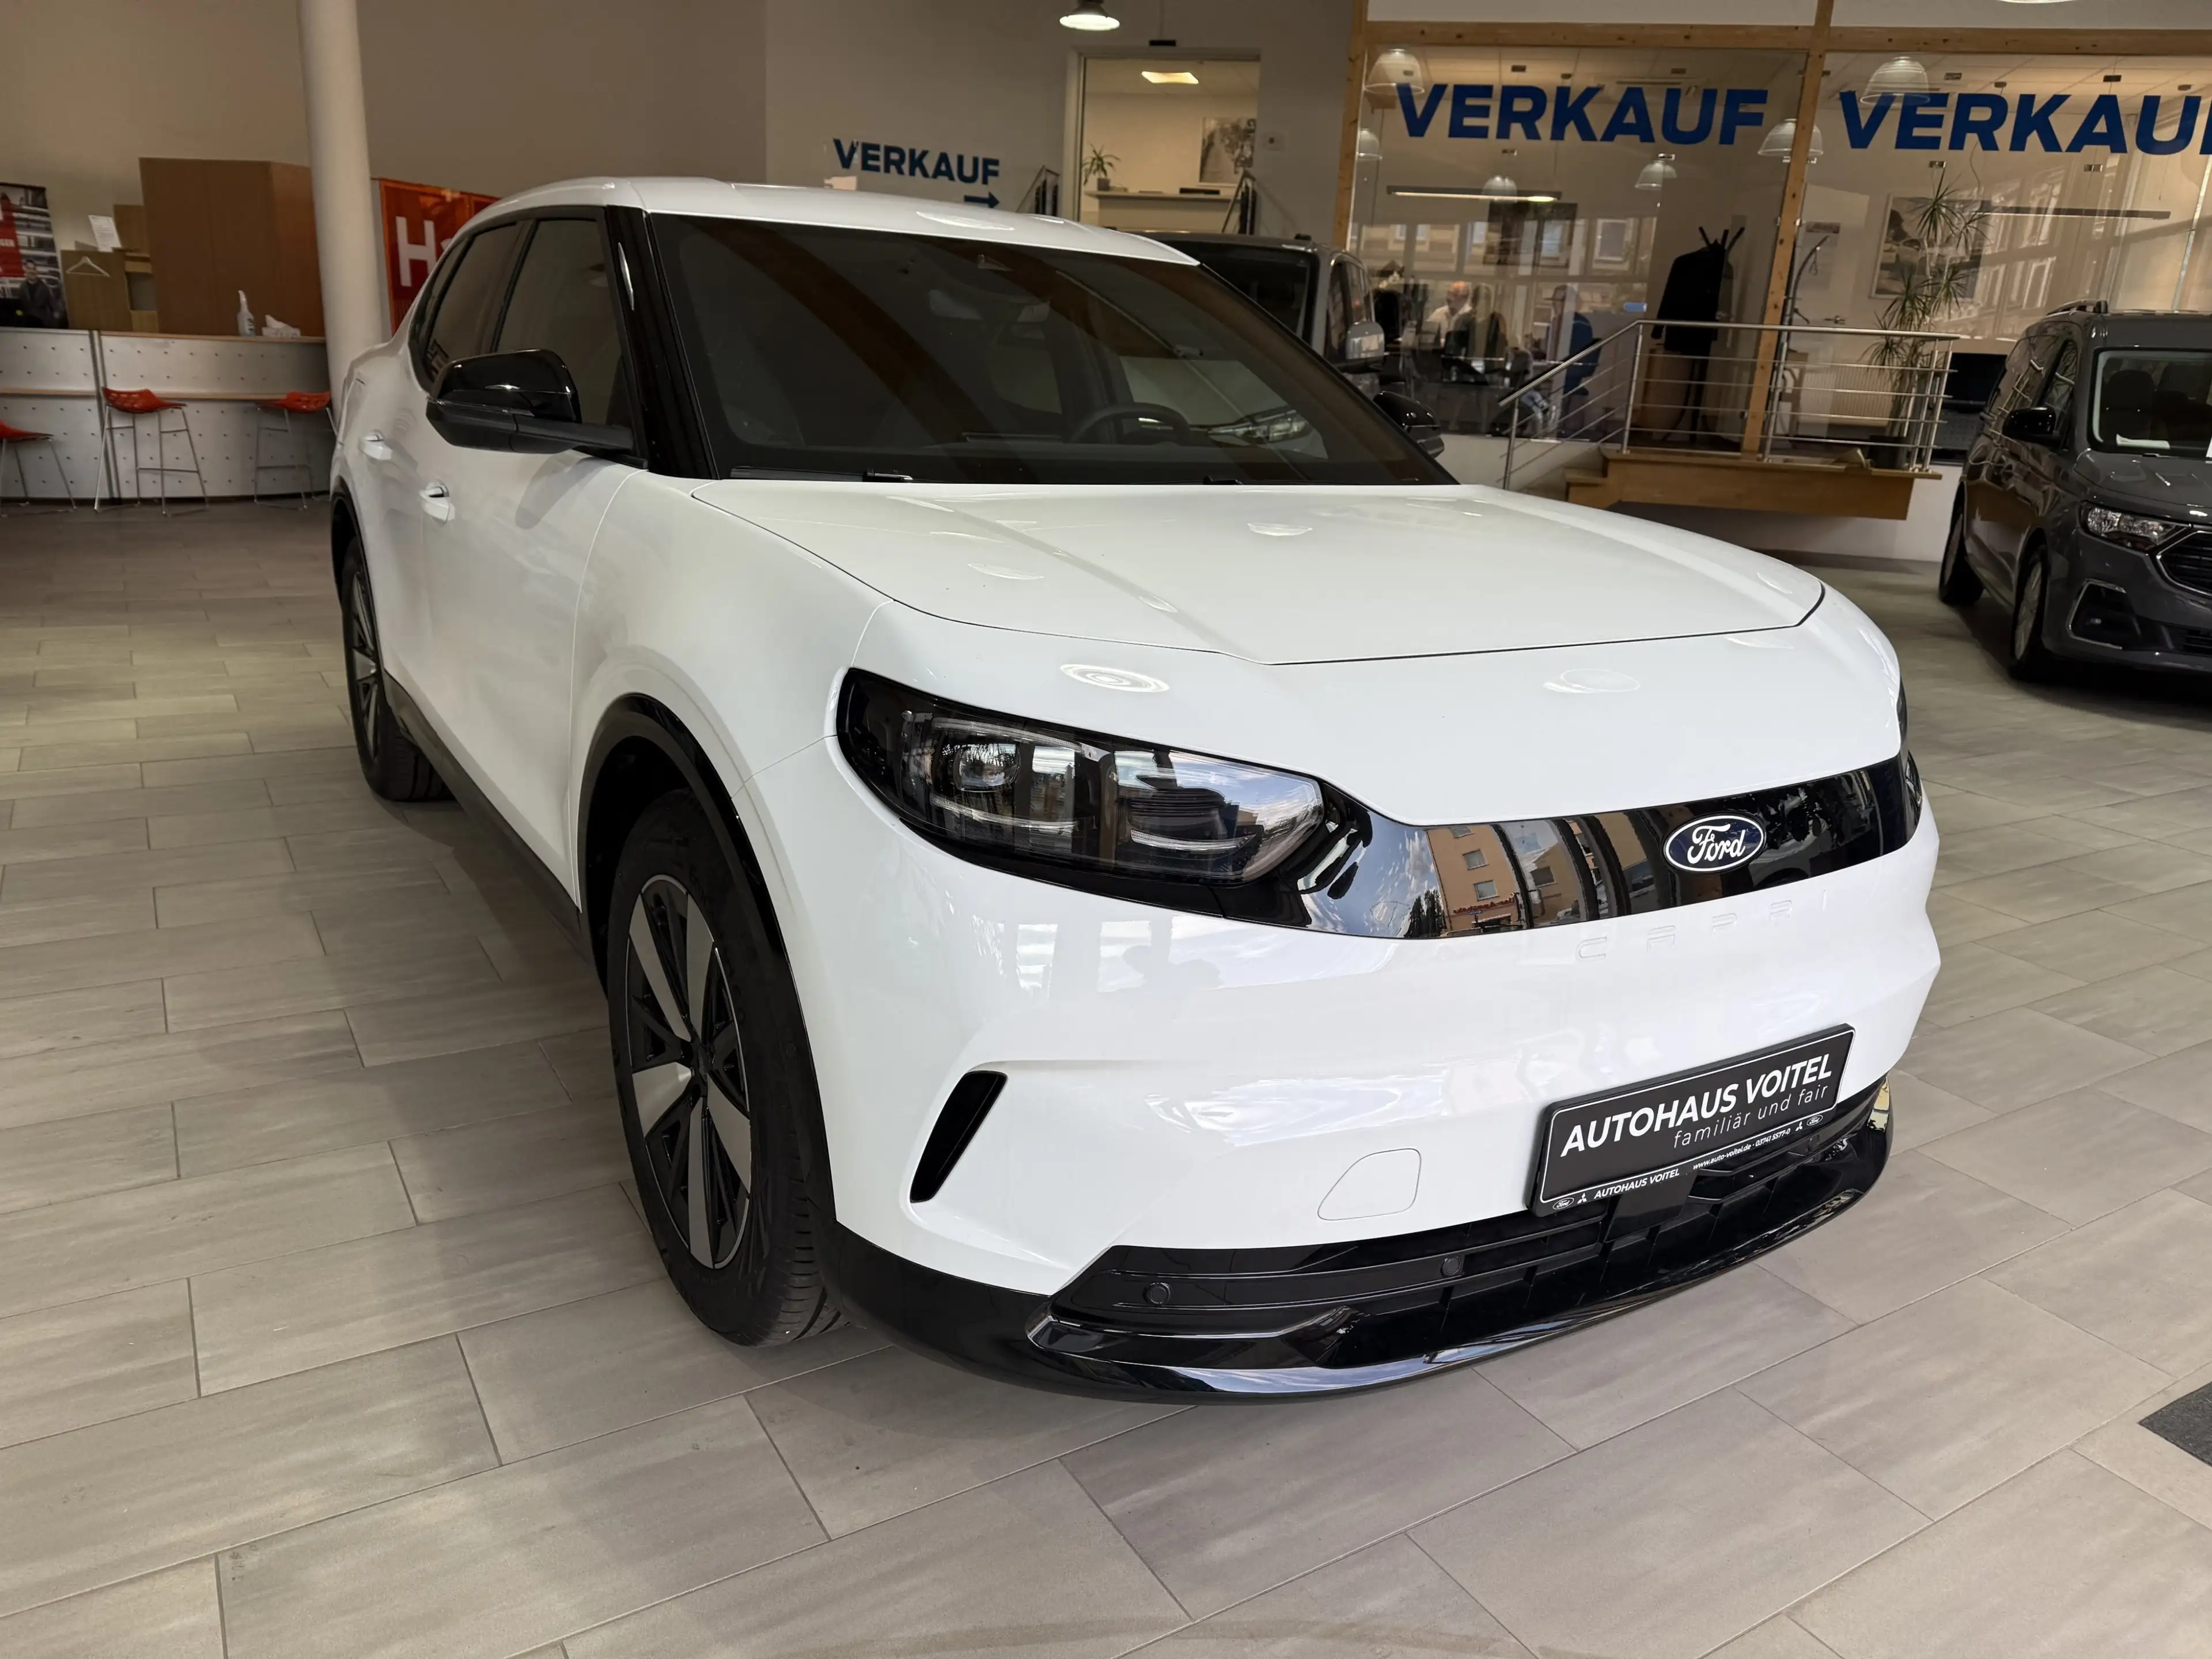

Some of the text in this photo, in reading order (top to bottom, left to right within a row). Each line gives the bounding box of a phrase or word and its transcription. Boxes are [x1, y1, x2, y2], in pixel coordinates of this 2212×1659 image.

[1396, 82, 1768, 145] VERKAUF
[833, 138, 1000, 185] VERKAUF
[1687, 823, 1745, 864] Ford
[1560, 1054, 1832, 1157] AUTOHAUS VOITEL
[1673, 1085, 1829, 1148] familiär und fair
[1693, 1144, 1752, 1170] www.auto-voitel.de
[1771, 1128, 1791, 1141] 5577-0
[1593, 1168, 1680, 1199] AUTOHAUS VOITEL
